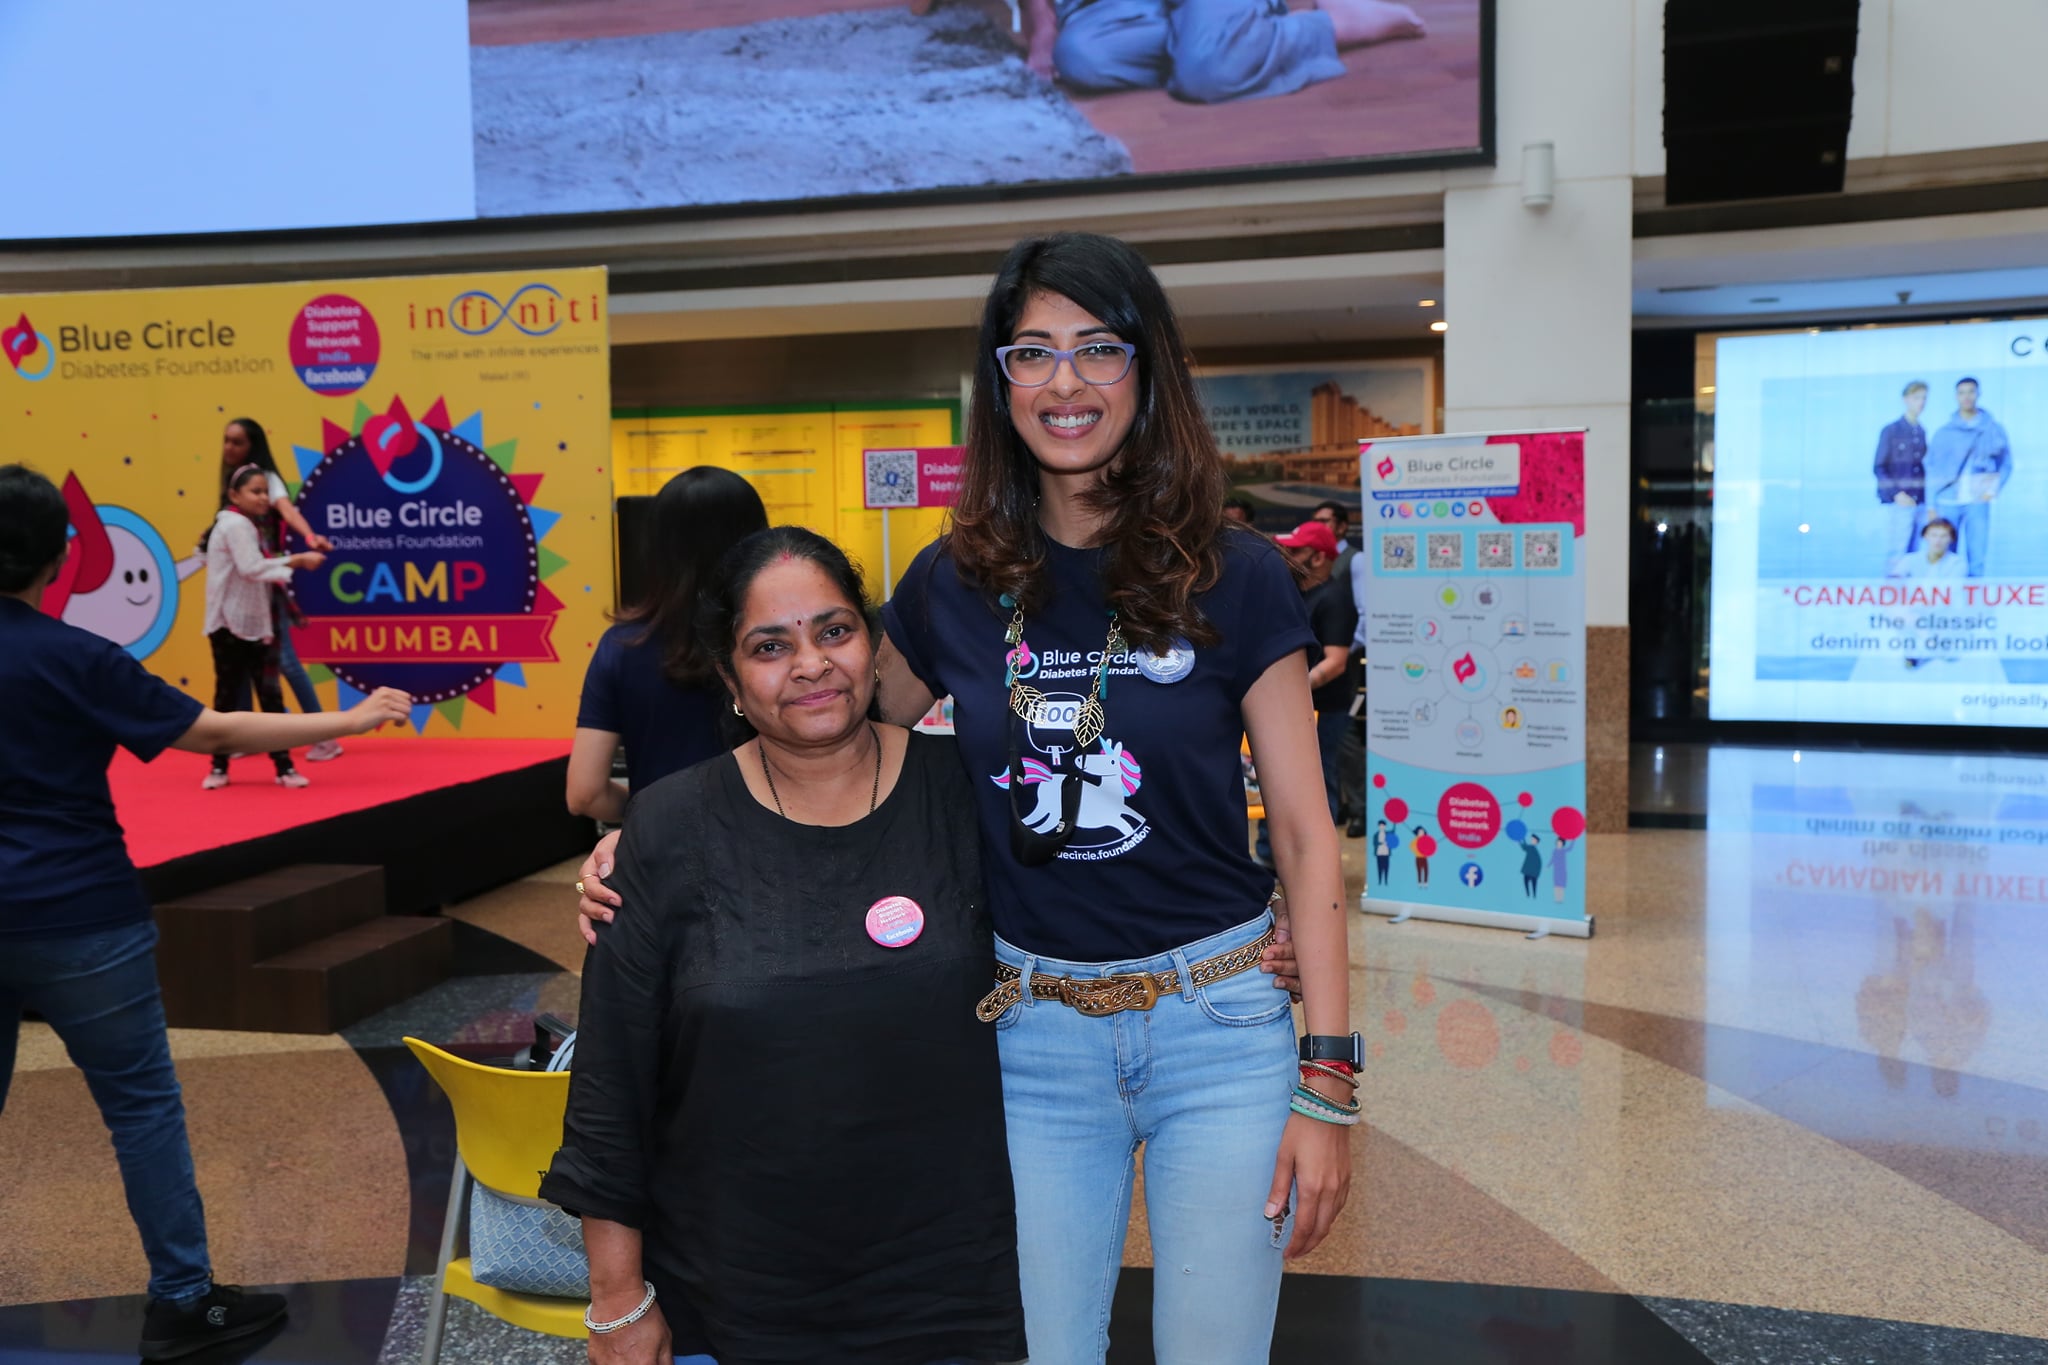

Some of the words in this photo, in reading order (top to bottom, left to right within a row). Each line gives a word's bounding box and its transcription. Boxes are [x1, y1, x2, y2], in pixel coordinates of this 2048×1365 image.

[304, 304, 362, 318] Diabetes
[306, 319, 360, 333] Support
[59, 323, 132, 352] Blue
[142, 318, 236, 350] Circle
[305, 334, 362, 348] Network
[2011, 336, 2048, 356] C
[61, 358, 150, 381] Diabetes
[155, 355, 274, 378] Foundation
[305, 366, 366, 384] facebook
[1256, 419, 1300, 431] SPACE
[1226, 433, 1301, 447] EVERYONE
[1407, 460, 1443, 473] Blue
[1448, 456, 1494, 471] Circle
[327, 502, 392, 529] Blue
[398, 500, 482, 527] Circle
[329, 534, 394, 550] Diabetes
[396, 533, 483, 549] Foundation
[329, 560, 487, 604] CAMP
[1869, 613, 1904, 630] the
[1915, 612, 1997, 630] classic
[330, 624, 498, 653] MUMBAI
[1811, 632, 1879, 651] denim
[1888, 636, 1916, 650] on
[1925, 632, 1997, 651] denim
[1042, 649, 1081, 666] Blue
[1039, 668, 1088, 679] Diabetes
[1448, 796, 1490, 809] Diabetes
[1450, 807, 1488, 819] Support
[1449, 819, 1490, 831] Network
[1054, 825, 1151, 860] uecircle.foundation
